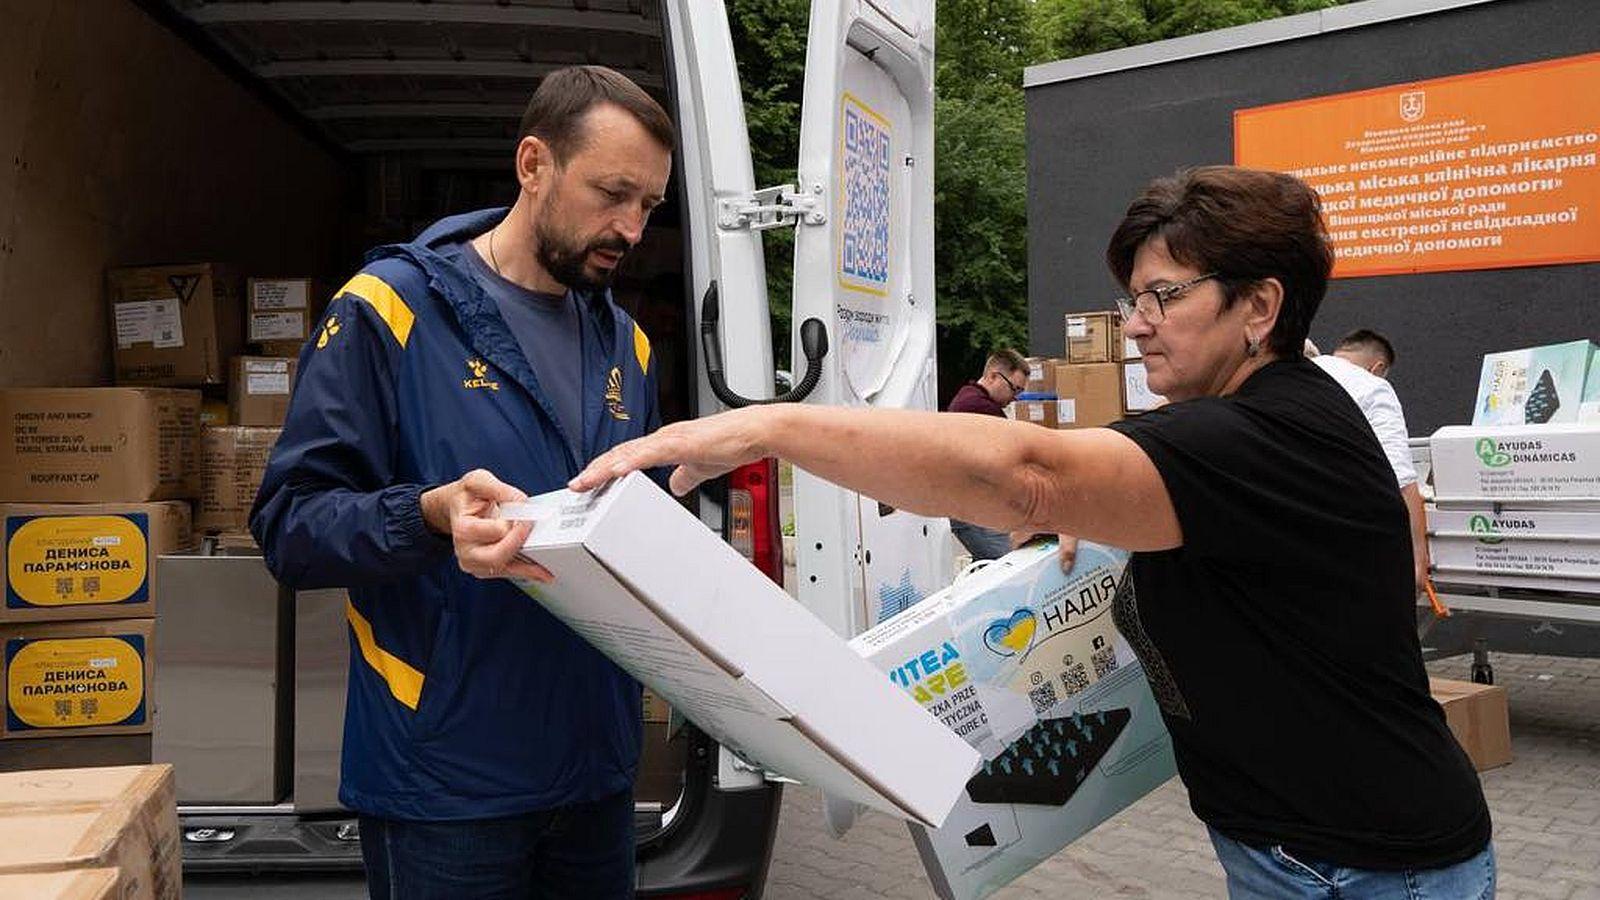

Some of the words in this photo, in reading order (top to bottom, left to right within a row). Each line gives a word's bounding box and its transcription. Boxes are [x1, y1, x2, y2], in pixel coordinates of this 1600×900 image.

[1284, 162, 1347, 178] нальне
[1350, 149, 1466, 171] некомерційне
[1470, 133, 1597, 157] підприємство
[1360, 174, 1419, 190] міська
[1424, 164, 1508, 184] клінічна
[1511, 152, 1597, 174] лікарня
[1360, 186, 1448, 208] медичної
[1451, 178, 1563, 201] допомоги»
[1329, 209, 1408, 226] Вінницької
[1409, 203, 1464, 219] міської
[1468, 201, 1506, 216] ради
[1361, 219, 1447, 239] екстреної
[1451, 206, 1578, 231] невідкладної
[1413, 235, 1502, 255] допомоги
[1497, 440, 1543, 451] AYUDAS
[1491, 519, 1536, 529] AYUDAS
[45, 548, 109, 560] ДЕНИСА
[24, 561, 131, 573] ПАРАМОНОВА
[1043, 574, 1117, 631] НАДІЯ
[44, 670, 107, 682] ДЕНИСА
[914, 663, 967, 704] ARE
[23, 683, 128, 696] ПАРАМОНОВА
[927, 699, 952, 717] ZKA
